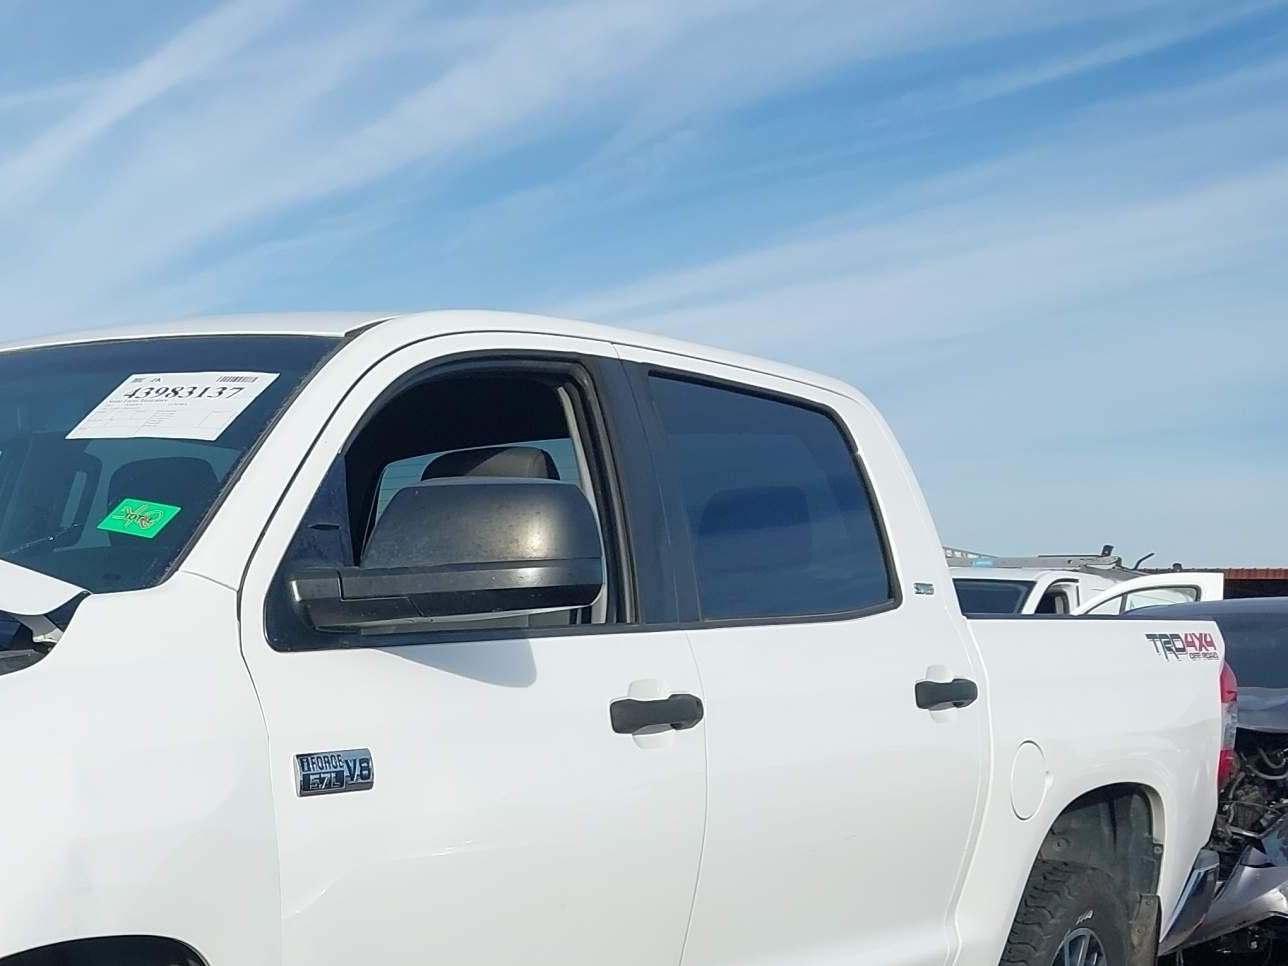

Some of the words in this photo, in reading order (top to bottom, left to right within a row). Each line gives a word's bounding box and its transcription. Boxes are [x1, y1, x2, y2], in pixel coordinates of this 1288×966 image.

[123, 386, 244, 399] 43983137
[1145, 633, 1186, 660] TRD
[345, 757, 371, 782] V8
